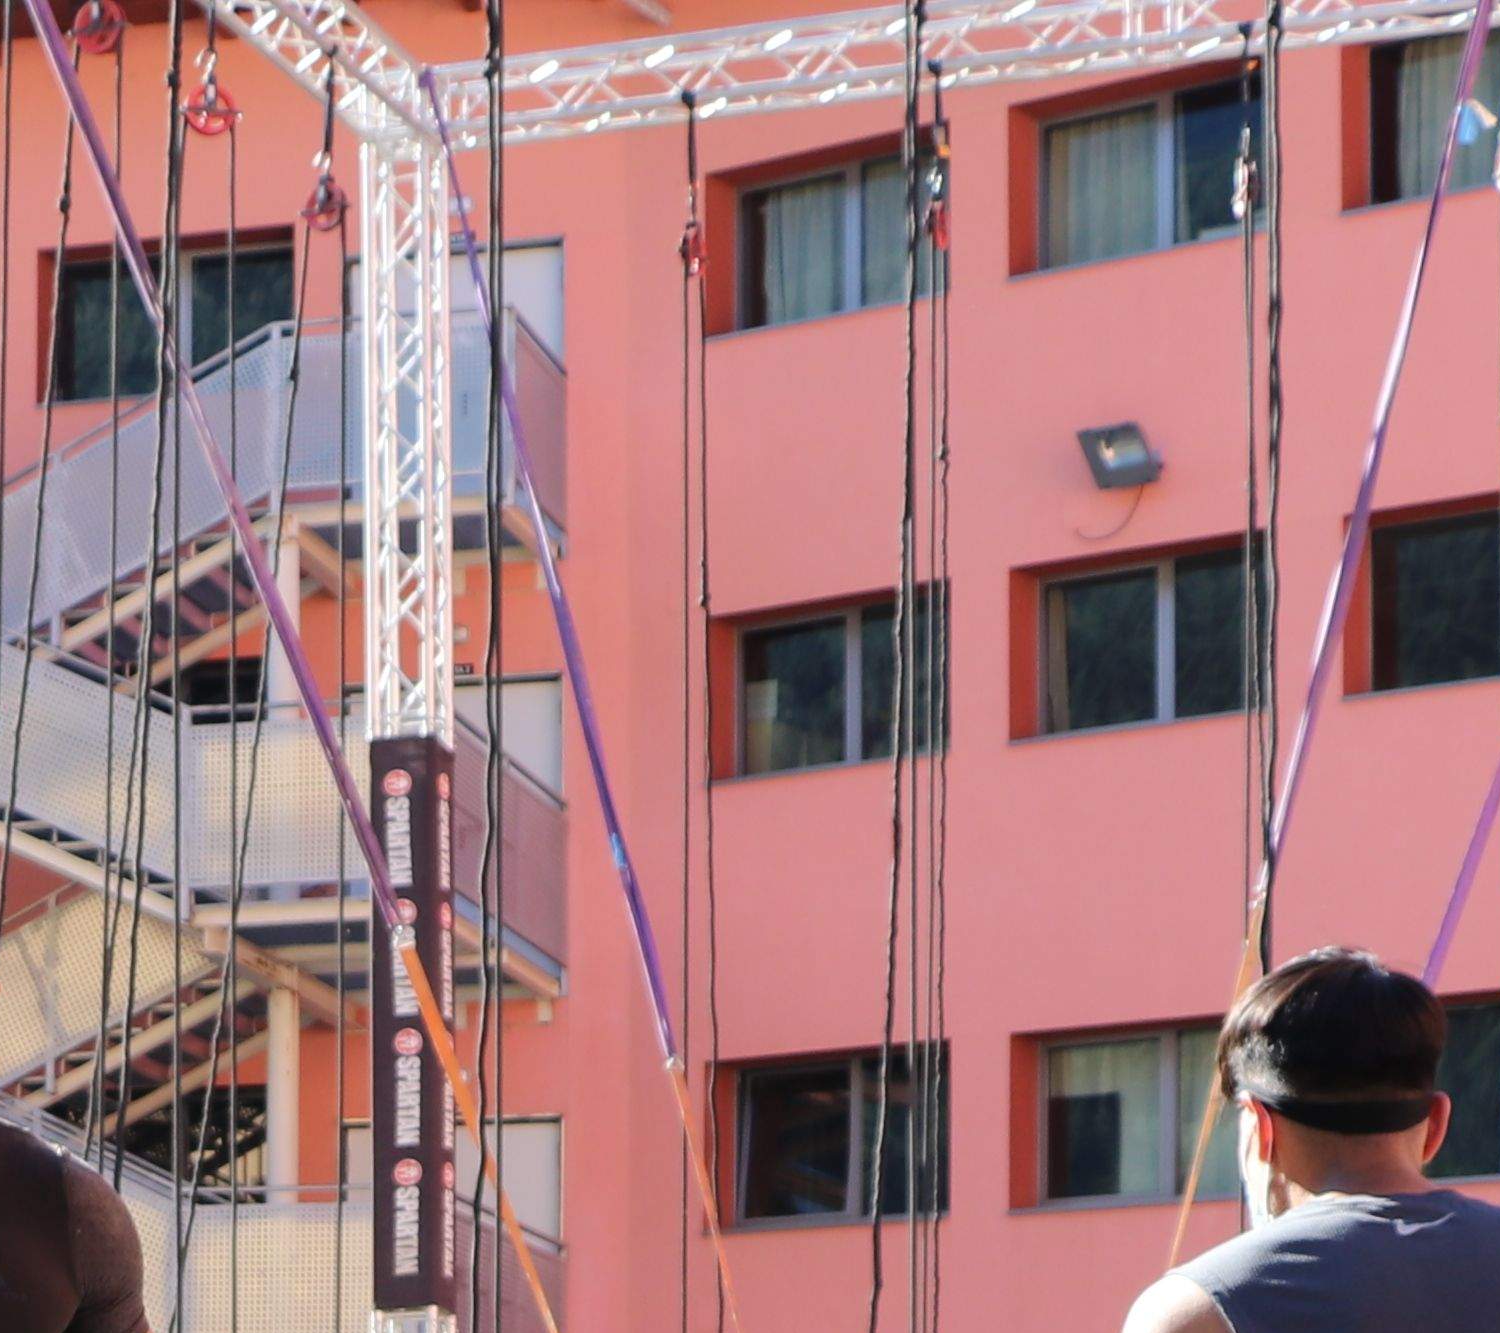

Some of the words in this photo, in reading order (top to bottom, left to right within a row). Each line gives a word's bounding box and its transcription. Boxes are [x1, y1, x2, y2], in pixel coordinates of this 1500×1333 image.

[386, 797, 413, 886] SPARTAN
[394, 1055, 421, 1147] SPARTAN
[393, 1185, 420, 1277] SPARTAN
